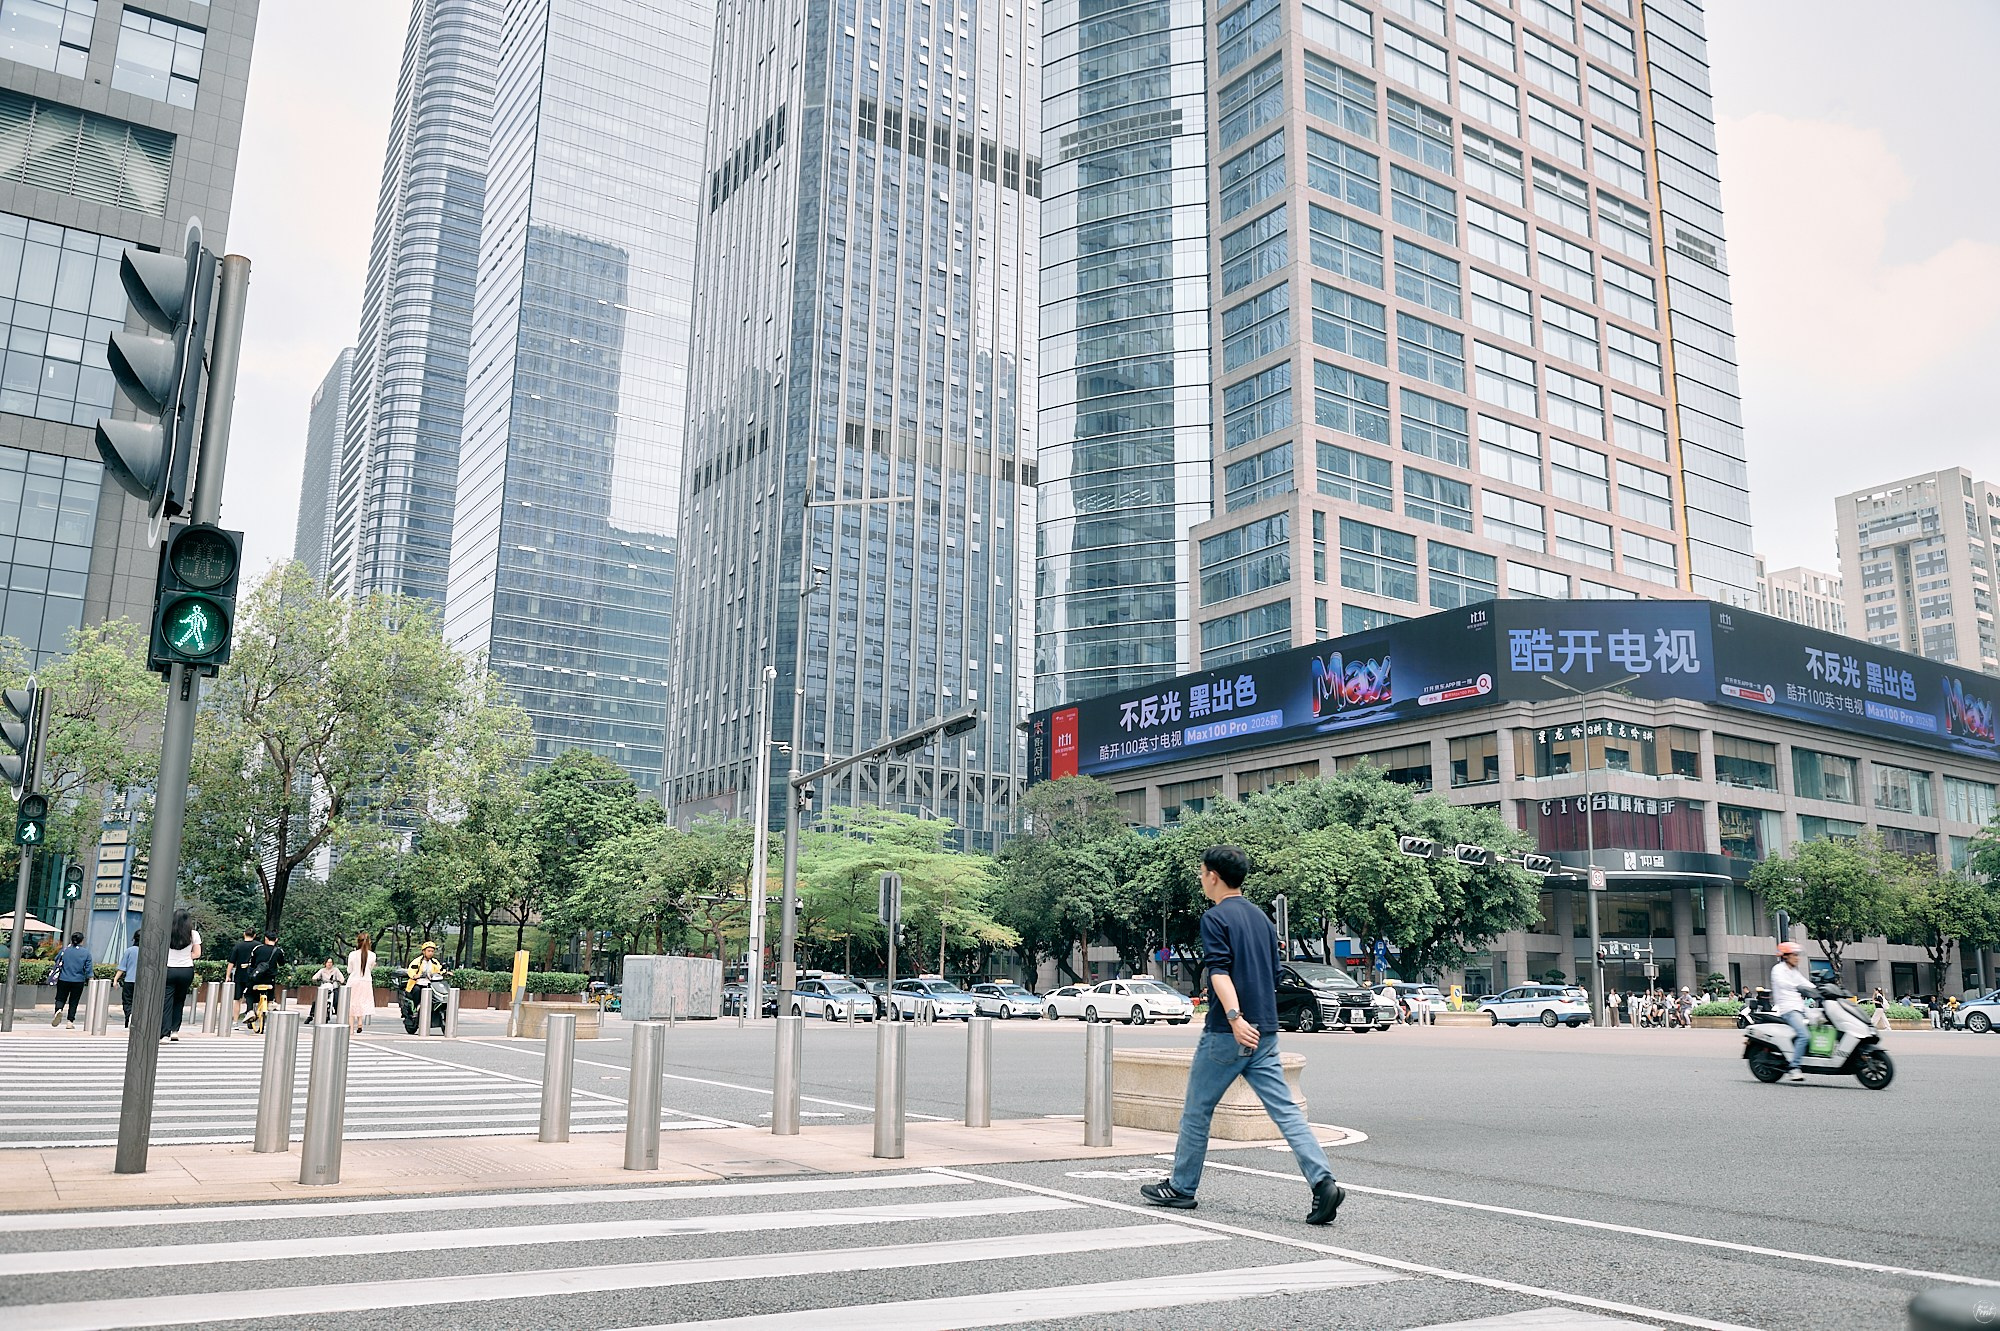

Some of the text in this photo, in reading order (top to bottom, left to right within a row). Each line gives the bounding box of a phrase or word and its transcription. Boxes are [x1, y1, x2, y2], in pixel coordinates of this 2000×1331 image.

[1508, 628, 1700, 674] 酷开电视
[1805, 646, 1917, 702] 不反光 黑出色
[1119, 674, 1257, 732] 不反光 黑出色
[1311, 652, 1391, 718] Max
[1786, 683, 1864, 715] 酷开100英寸电视
[1867, 705, 1899, 721] Max100
[1900, 710, 1914, 724] Pro
[1099, 715, 1279, 761] 酷开100英寸电视 Max100 Pro 2026款
